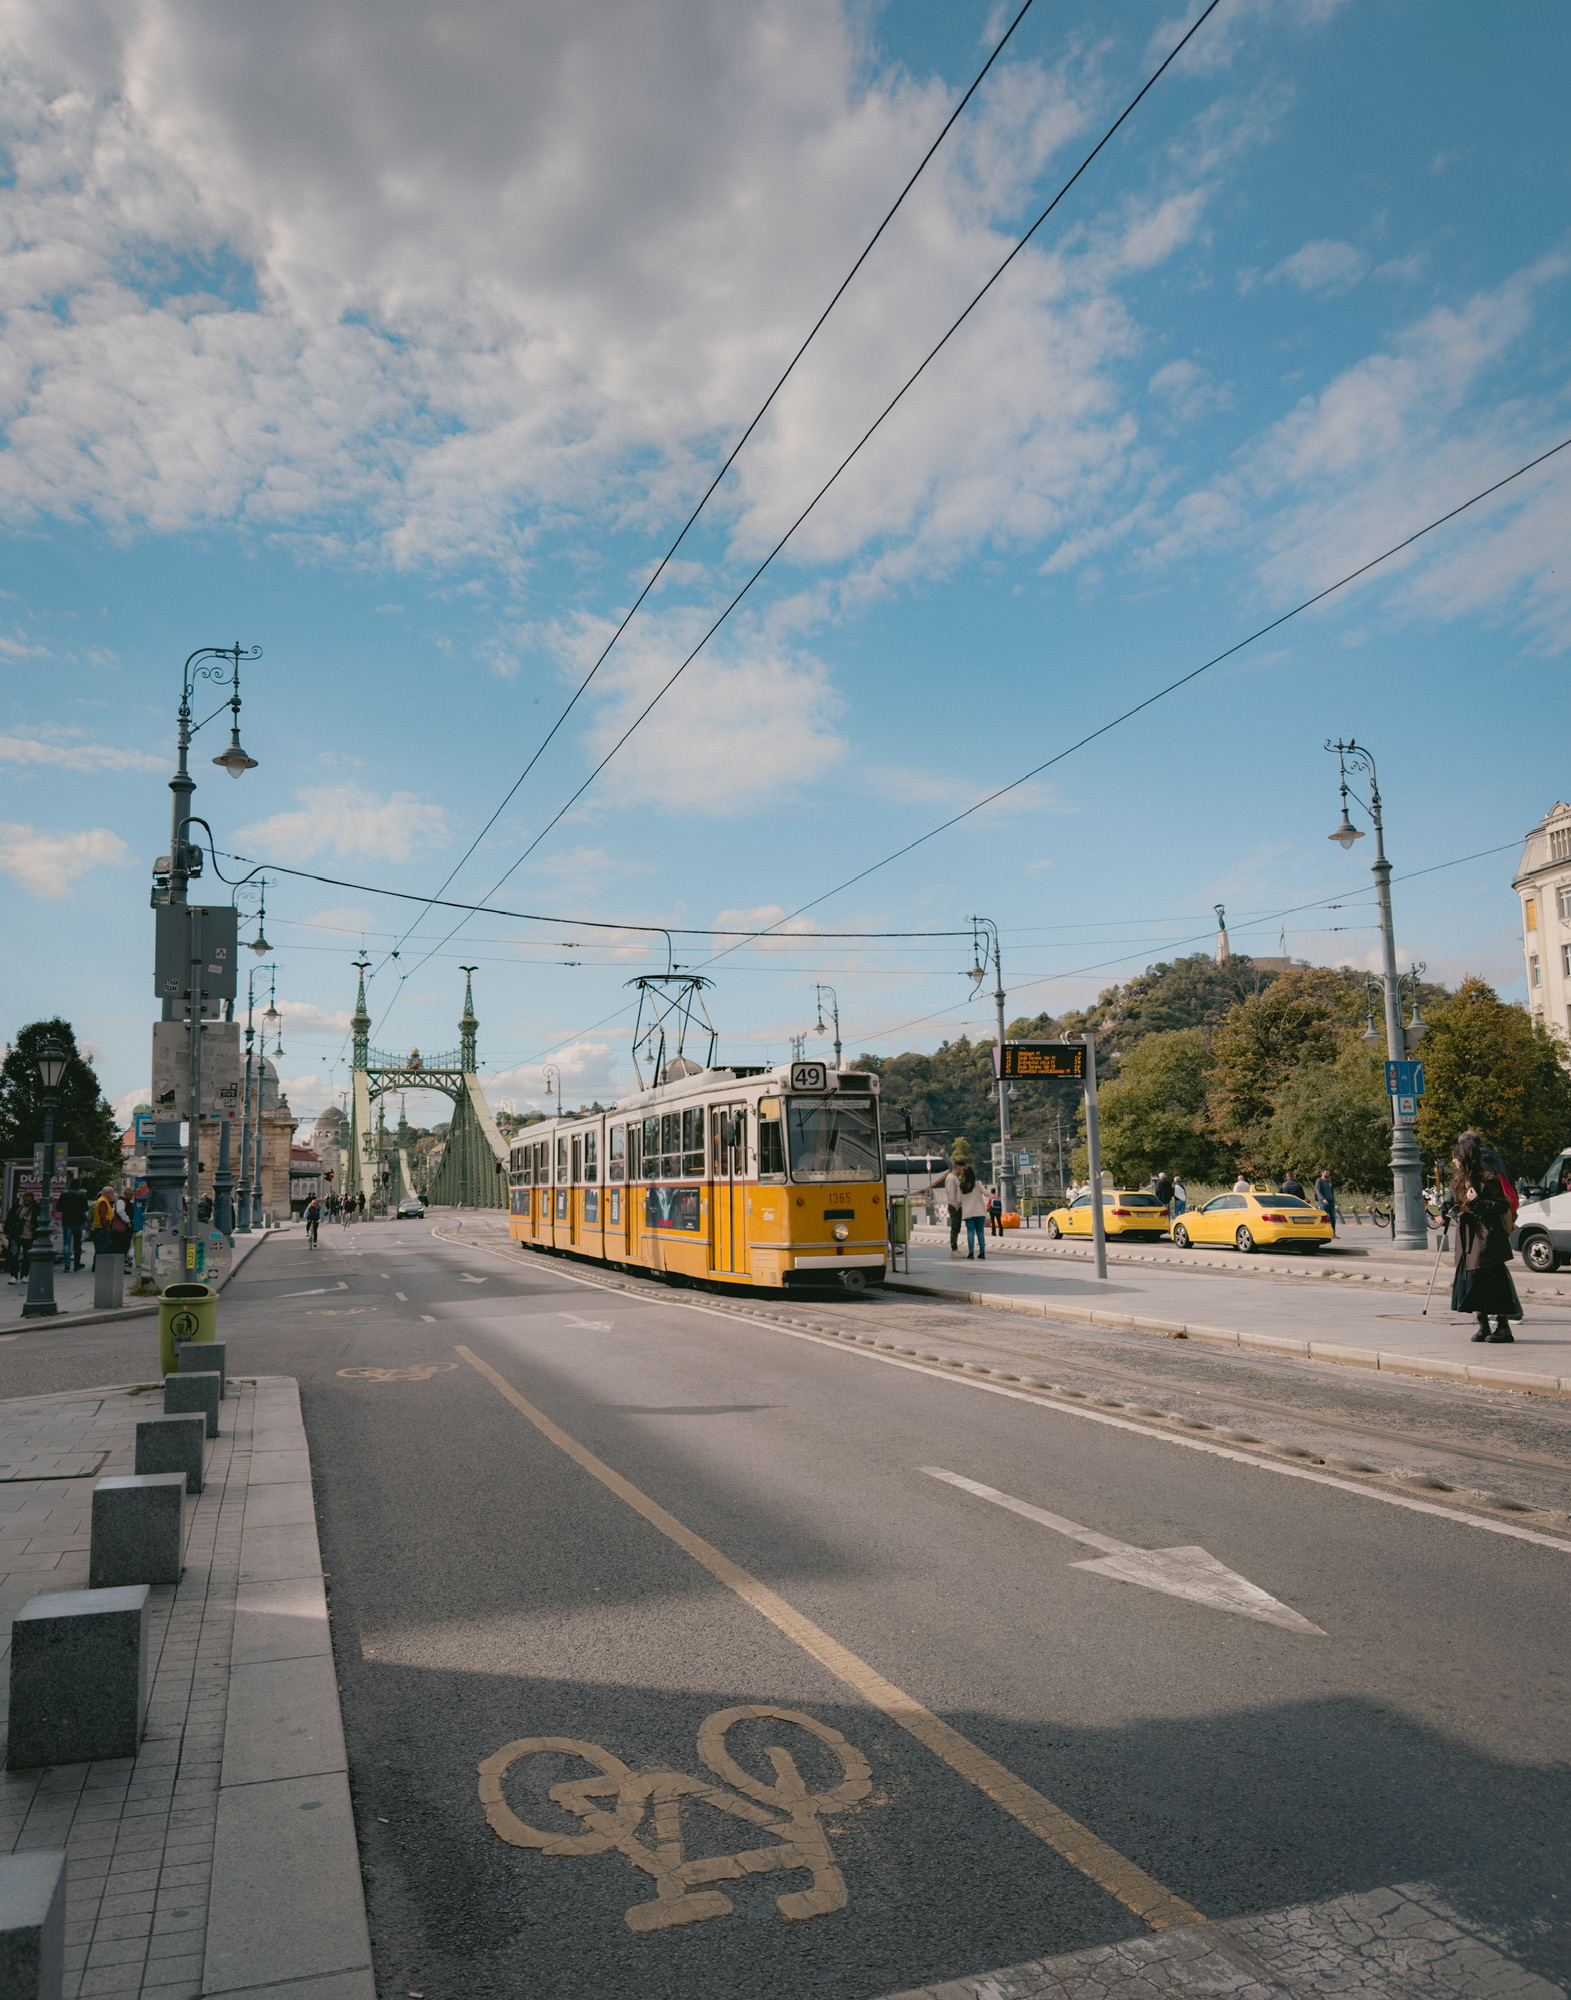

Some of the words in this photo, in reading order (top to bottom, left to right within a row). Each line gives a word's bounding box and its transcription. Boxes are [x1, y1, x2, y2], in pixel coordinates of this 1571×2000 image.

[795, 1068, 820, 1086] 49
[20, 1174, 67, 1183] DUPAN
[829, 1192, 852, 1205] 1365
